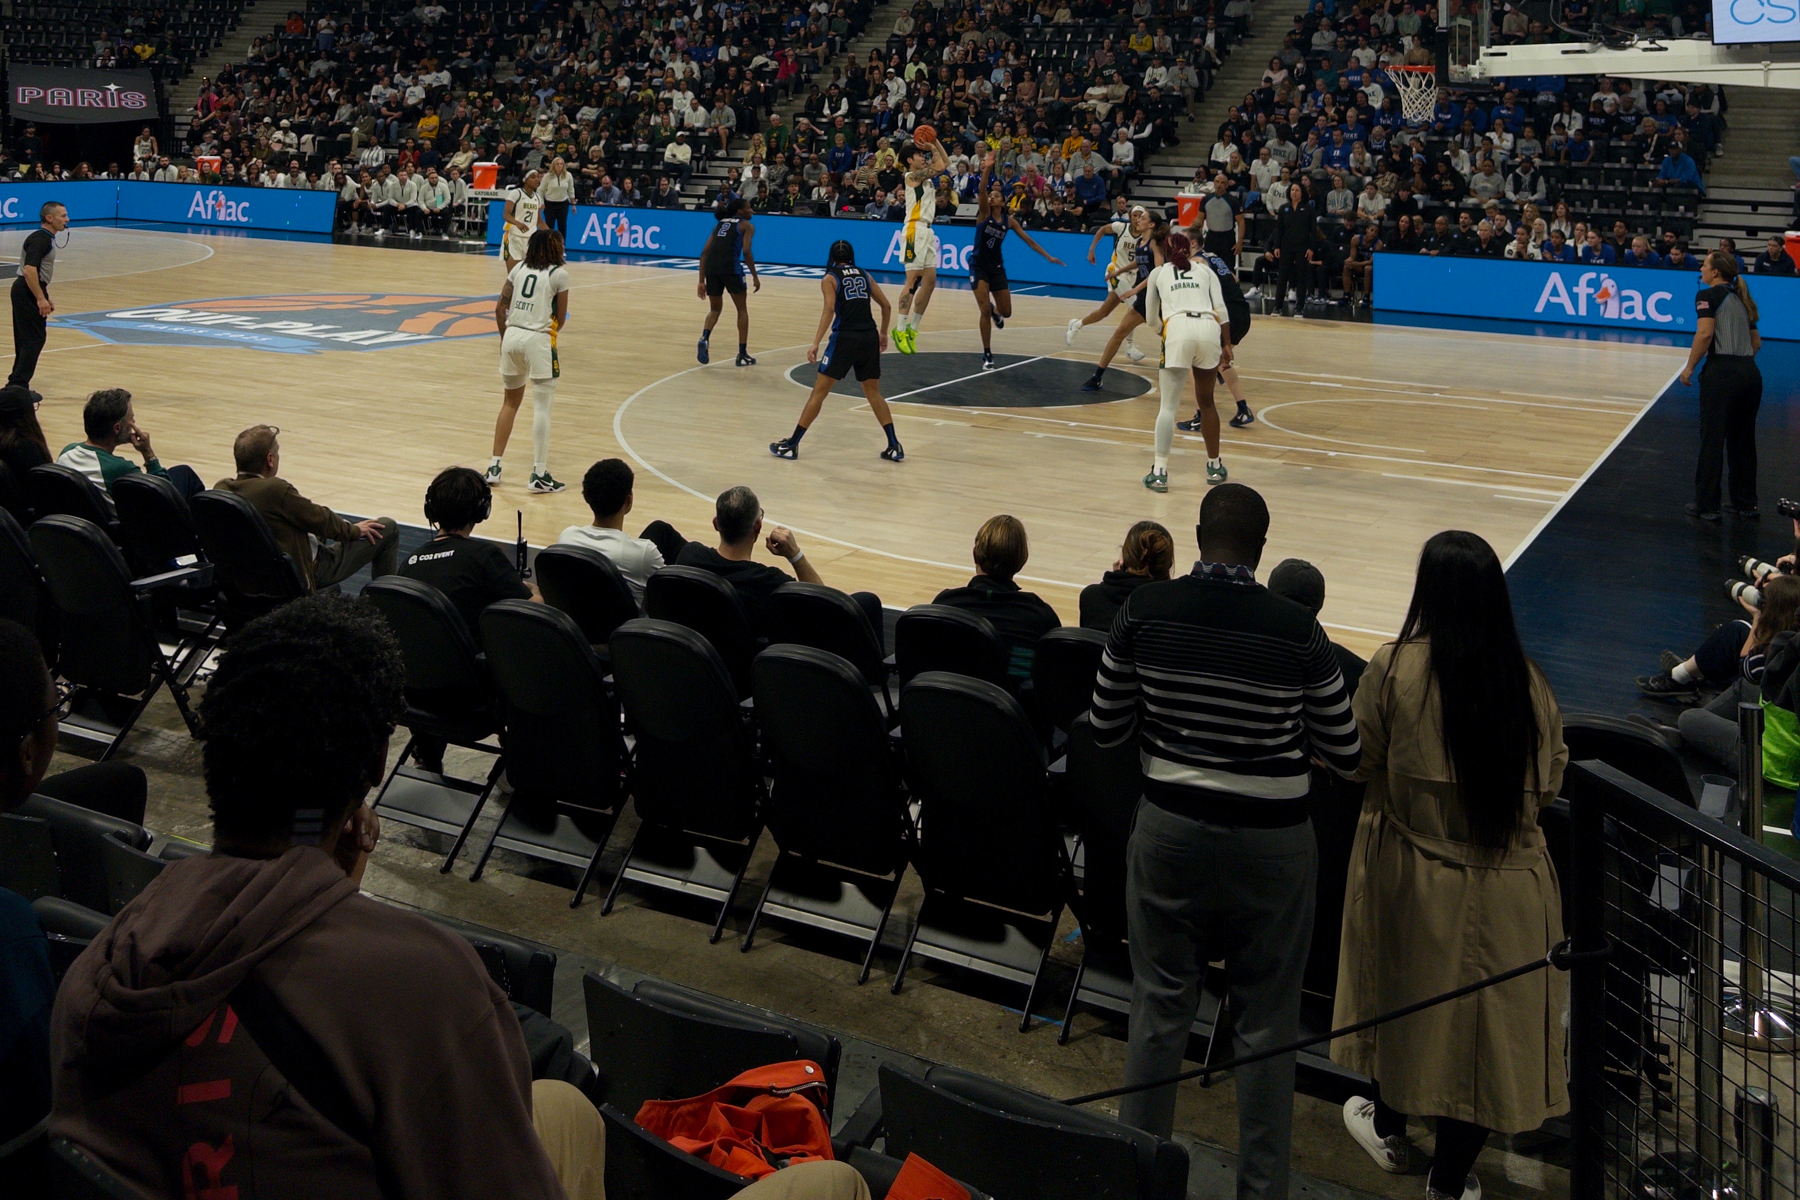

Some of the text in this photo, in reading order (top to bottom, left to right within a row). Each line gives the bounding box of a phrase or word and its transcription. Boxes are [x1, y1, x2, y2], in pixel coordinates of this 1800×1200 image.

[17, 85, 147, 109] PARIS
[187, 190, 250, 223] Aflac
[523, 211, 534, 223] 21
[580, 212, 661, 250] Aflac
[717, 222, 731, 237] 2
[986, 238, 996, 249] 4
[1123, 240, 1136, 249] BEA
[1127, 250, 1136, 262] 5
[842, 268, 861, 276] MAIR
[1173, 266, 1193, 281] 12
[521, 274, 538, 299] 0
[842, 276, 869, 300] 22
[1170, 282, 1200, 292] ABRAHAM
[1534, 271, 1673, 323] Aflac
[514, 300, 534, 312] SCOTT
[106, 309, 445, 345] OUI-PLAY
[137, 323, 273, 342] PARIS 2025
[418, 549, 455, 562] CO2 EVENT
